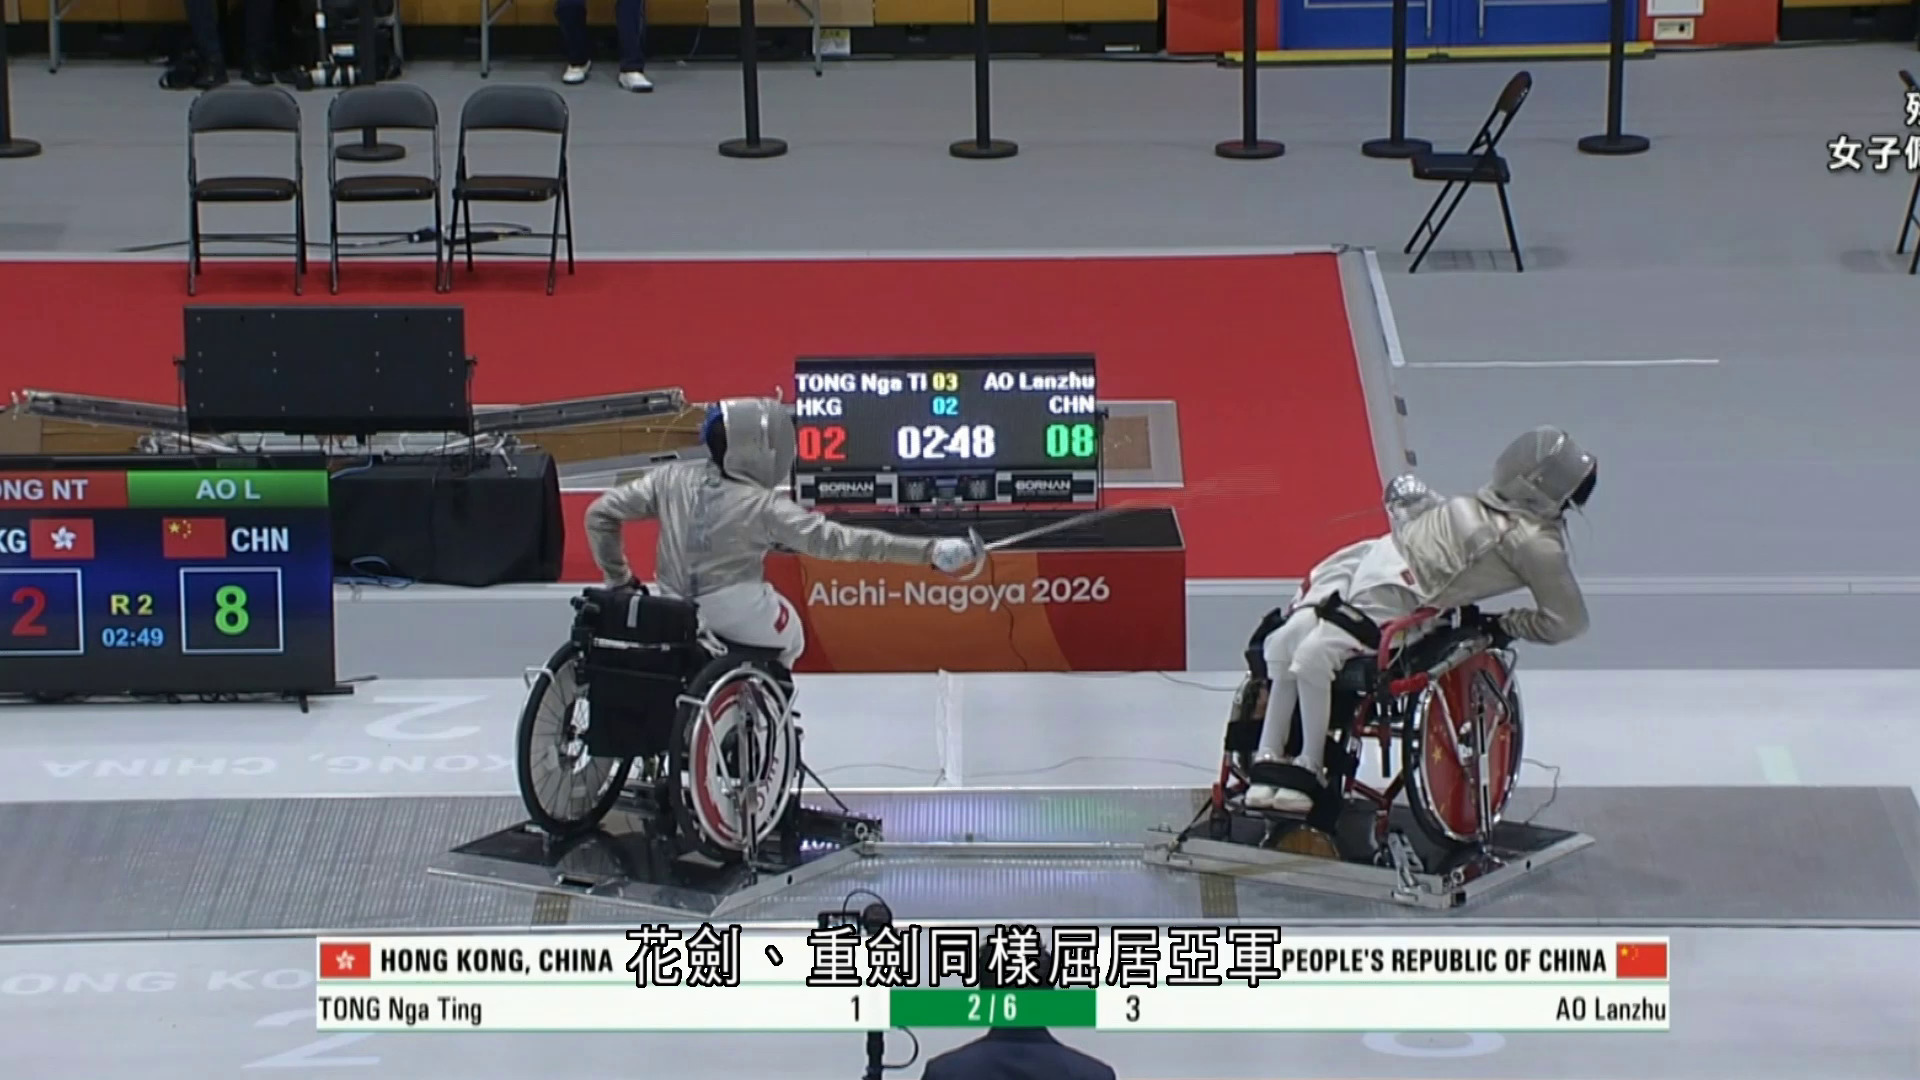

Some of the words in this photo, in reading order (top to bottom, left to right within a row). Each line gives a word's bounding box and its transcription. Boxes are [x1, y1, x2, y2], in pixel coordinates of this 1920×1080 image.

[795, 372, 857, 393] TONG
[861, 372, 903, 396] Nga
[932, 371, 958, 391] 03
[984, 371, 1014, 391] AO
[1019, 370, 1095, 391] Lanzhu
[796, 397, 843, 417] HKG
[932, 396, 958, 415] 02
[1049, 394, 1095, 414] CHN
[798, 425, 847, 460] 02
[1046, 423, 1095, 458] 08
[52, 479, 89, 500] NT
[195, 478, 237, 500] AO
[244, 479, 261, 500] L
[231, 527, 290, 553] CHN
[110, 594, 131, 616] R
[137, 594, 154, 616] 2
[807, 578, 1026, 613] Aichi-Nagoya
[1031, 576, 1111, 604] 2026
[11, 586, 48, 637] 2
[214, 584, 249, 636] 8
[101, 627, 164, 648] 02:49
[42, 756, 277, 778] CHINA
